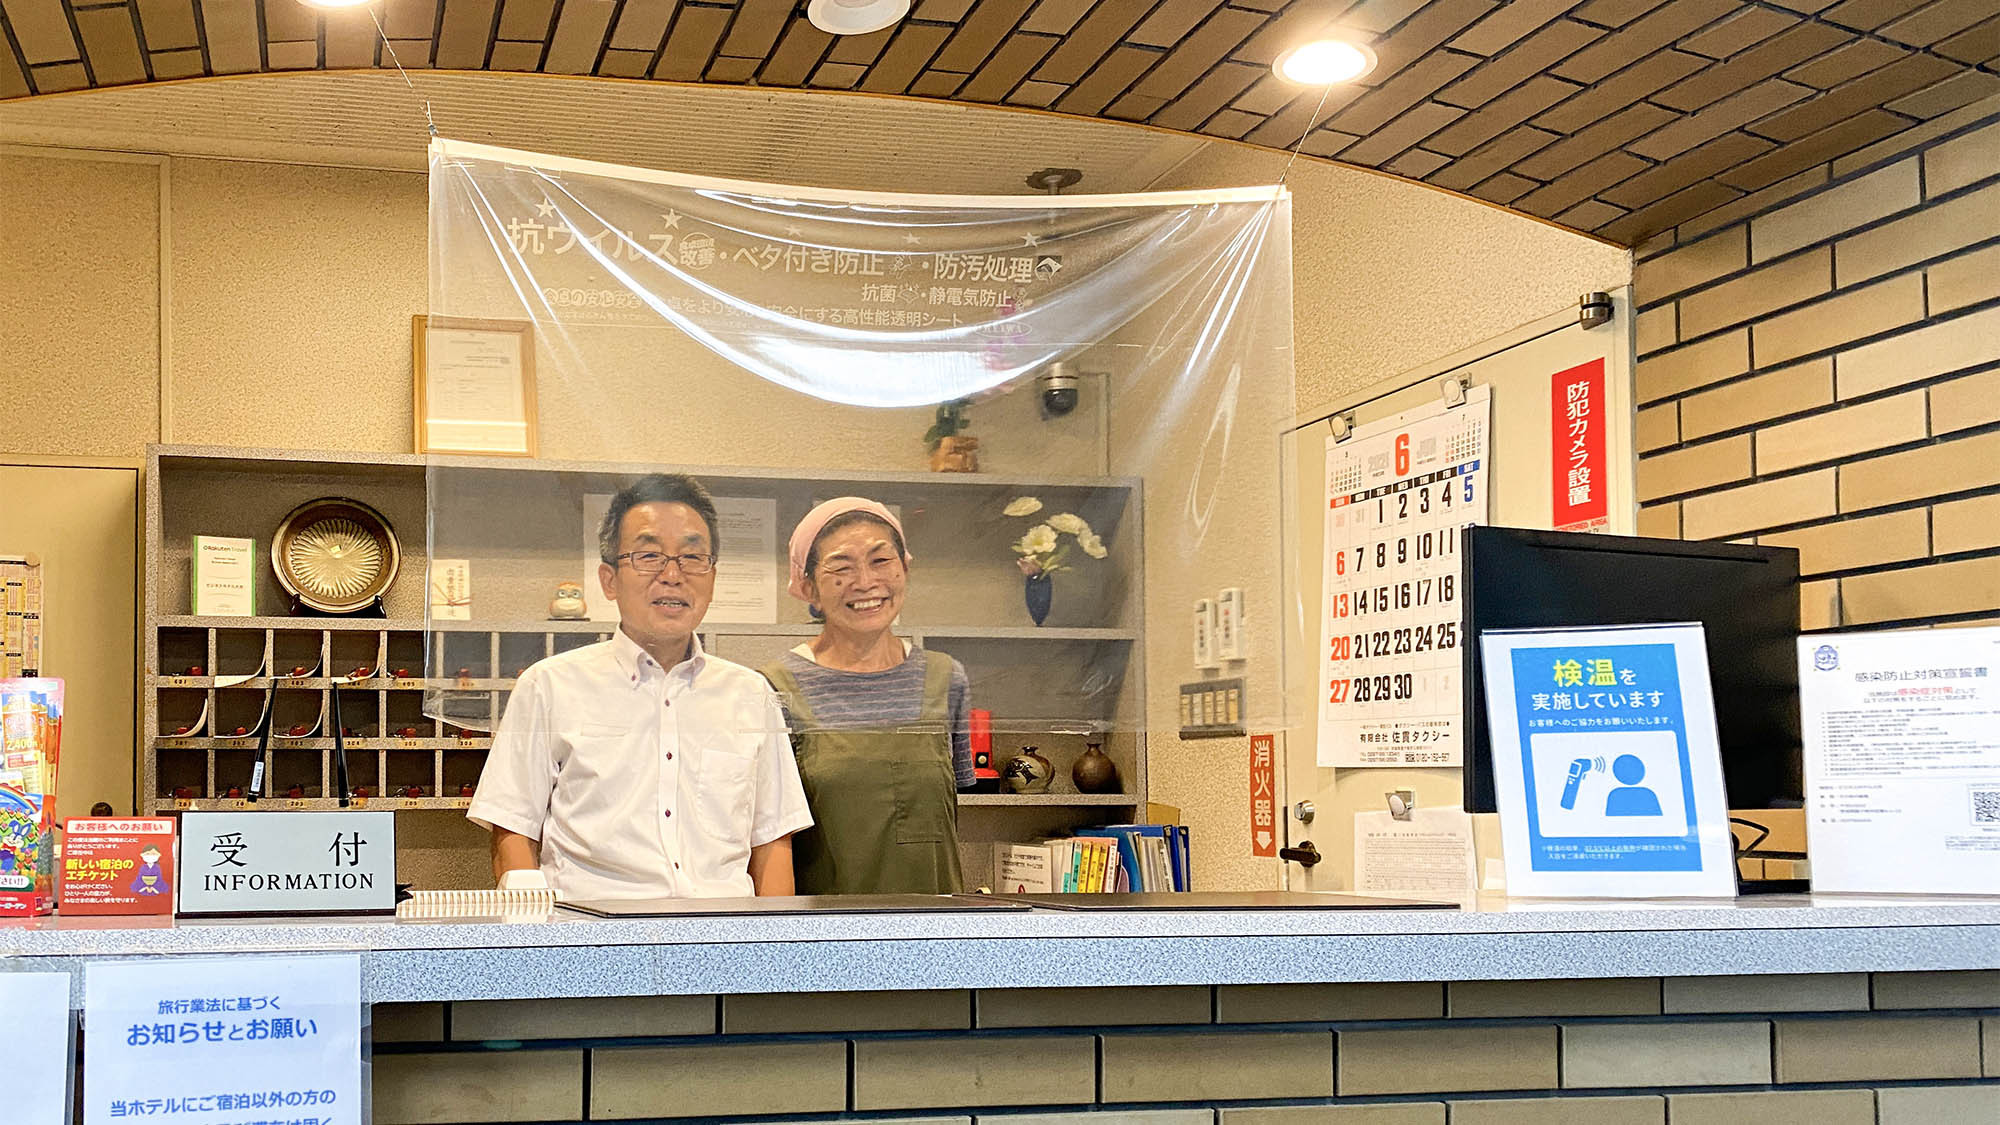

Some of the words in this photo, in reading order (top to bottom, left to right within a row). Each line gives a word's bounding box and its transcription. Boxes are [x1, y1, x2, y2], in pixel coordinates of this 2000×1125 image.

[861, 283, 897, 303] 抗菌
[1395, 433, 1410, 477] 6
[1566, 380, 1592, 507] 防犯カメラ設置
[1378, 499, 1384, 523] 1
[1399, 493, 1408, 519] 2
[1420, 487, 1430, 514] 3
[1441, 481, 1452, 507] 4
[1463, 475, 1474, 503] 5
[1336, 551, 1345, 576] 6
[1355, 547, 1365, 572] 7
[1376, 542, 1386, 568] 8
[1397, 538, 1407, 564] 9
[1416, 532, 1433, 561] 10
[1439, 527, 1454, 556] 11
[1333, 593, 1349, 619] 13
[1354, 590, 1368, 616] 14
[1373, 586, 1388, 613] 15
[1394, 582, 1411, 609] 16
[1416, 579, 1432, 606] 17
[1438, 575, 1454, 603] 18
[1331, 635, 1350, 661] 20
[1354, 633, 1369, 659] 21
[1373, 630, 1391, 657] 22
[1394, 627, 1411, 654] 23
[1415, 625, 1433, 652] 24
[1437, 622, 1456, 650] 25
[1553, 658, 1637, 688] 検温を
[1855, 667, 1988, 682] 感染防止対策宣誓書
[1330, 679, 1350, 704] 27
[1354, 677, 1371, 702] 28
[1373, 675, 1391, 701] 29
[1394, 673, 1413, 700] 30
[1531, 690, 1665, 711] 実施しています
[1360, 733, 1388, 742] 有限会社
[1392, 730, 1450, 743] 佐貫タクシー
[1528, 716, 1675, 728] お客様へのご協力をお願いいたします。
[1254, 739, 1273, 827] 消火器
[74, 823, 163, 832] お客様へのお願い
[65, 859, 134, 870] 新しい宿泊の
[65, 870, 119, 881] エチケット
[204, 873, 374, 891] INFORMATION
[158, 996, 280, 1015] 旅行業法に基づく
[127, 1017, 318, 1046] お知らせとお願い
[110, 1089, 337, 1118] 当ホテルにご宿泊以外の方の
